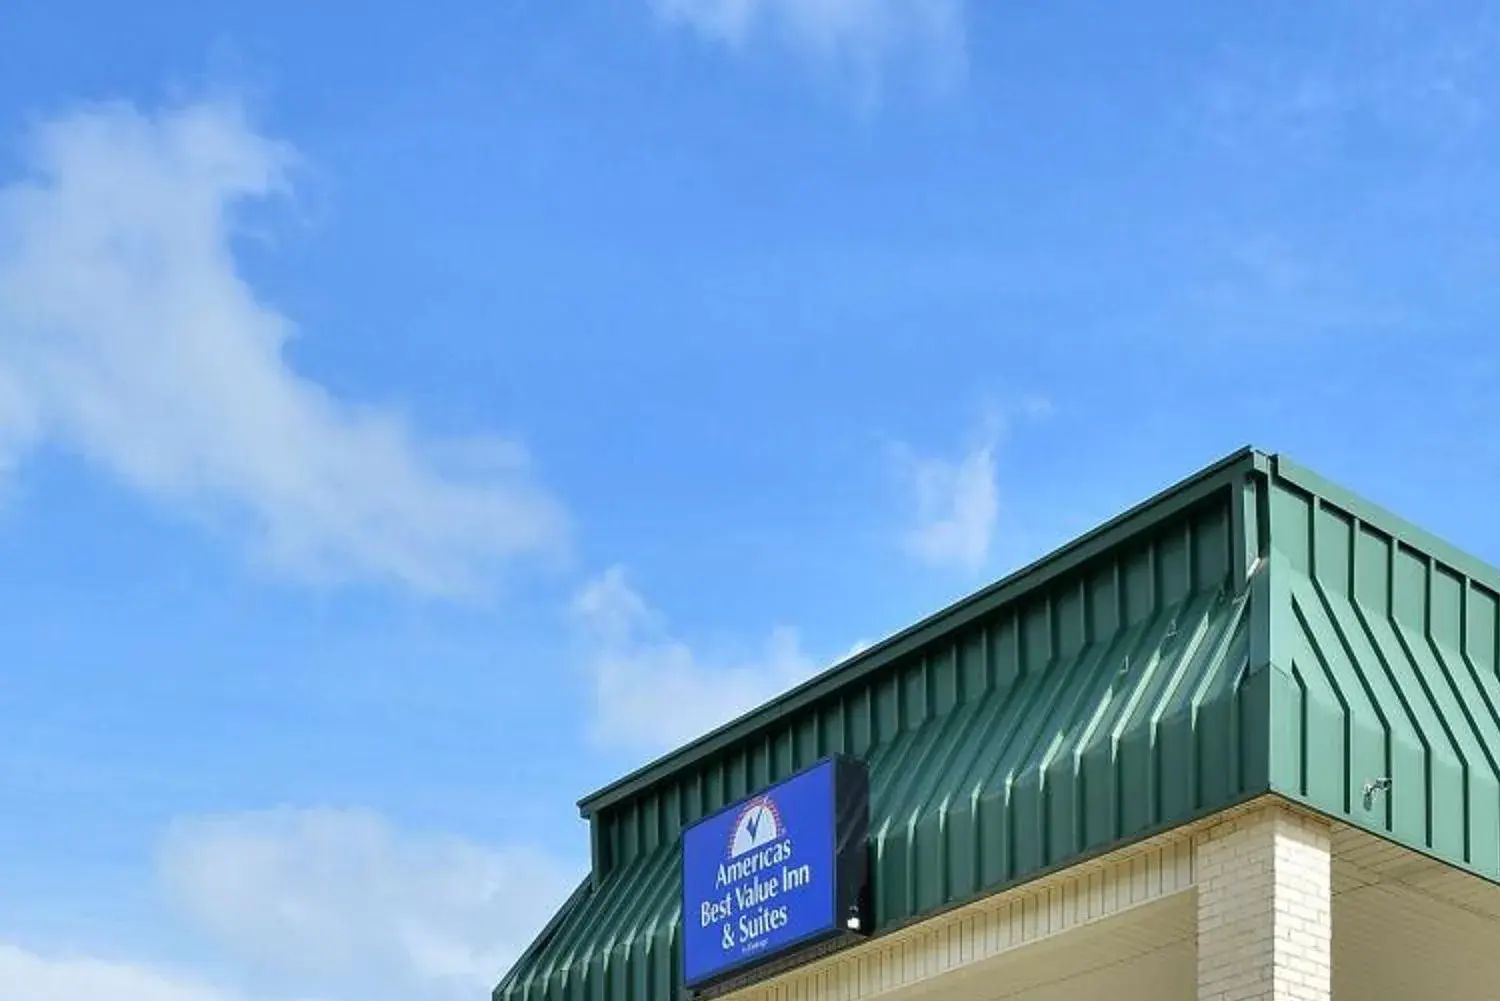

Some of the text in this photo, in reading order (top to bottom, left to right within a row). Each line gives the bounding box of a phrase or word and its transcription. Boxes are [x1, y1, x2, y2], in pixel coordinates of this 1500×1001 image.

[716, 838, 791, 887] Americas
[701, 865, 810, 927] Best Value Inn
[722, 925, 735, 950] &
[739, 905, 787, 942] Suites
